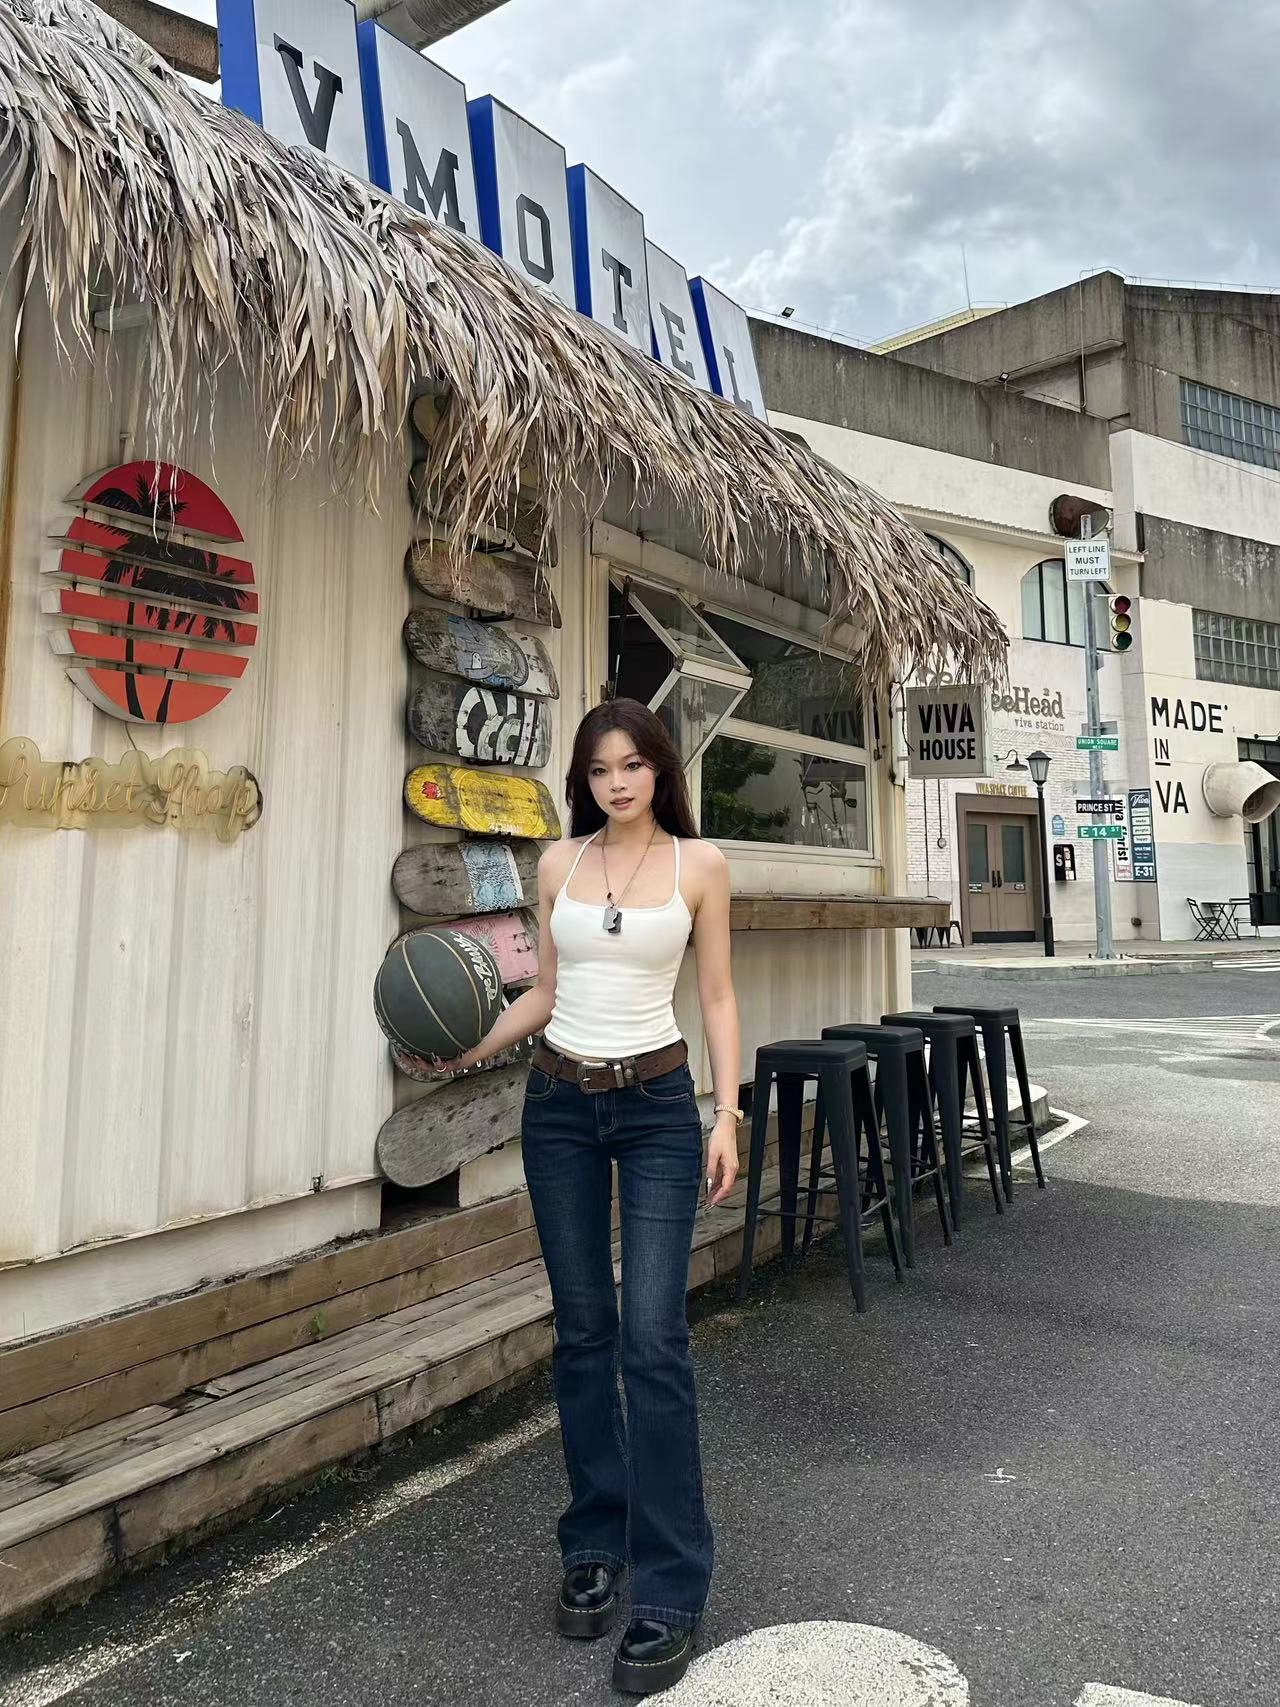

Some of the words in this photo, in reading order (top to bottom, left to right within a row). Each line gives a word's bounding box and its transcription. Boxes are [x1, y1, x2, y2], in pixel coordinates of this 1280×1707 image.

[1068, 546, 1087, 554] LEFT
[1088, 545, 1106, 553] LINE
[1075, 556, 1100, 565] MUST
[1070, 568, 1089, 576] TURN
[1091, 567, 1107, 575] LEFT
[918, 703, 976, 735] VIVA
[1014, 718, 1033, 728] viva
[1035, 718, 1065, 732] station
[1096, 738, 1118, 746] SQUARE
[920, 738, 976, 761] HOUSE
[1154, 738, 1170, 761] IN
[1155, 780, 1190, 814] VA
[1077, 803, 1103, 812] PRINCE
[1104, 803, 1114, 812] ST
[1080, 827, 1089, 838] E
[1092, 827, 1108, 838] 14
[1135, 866, 1153, 877] E-31
